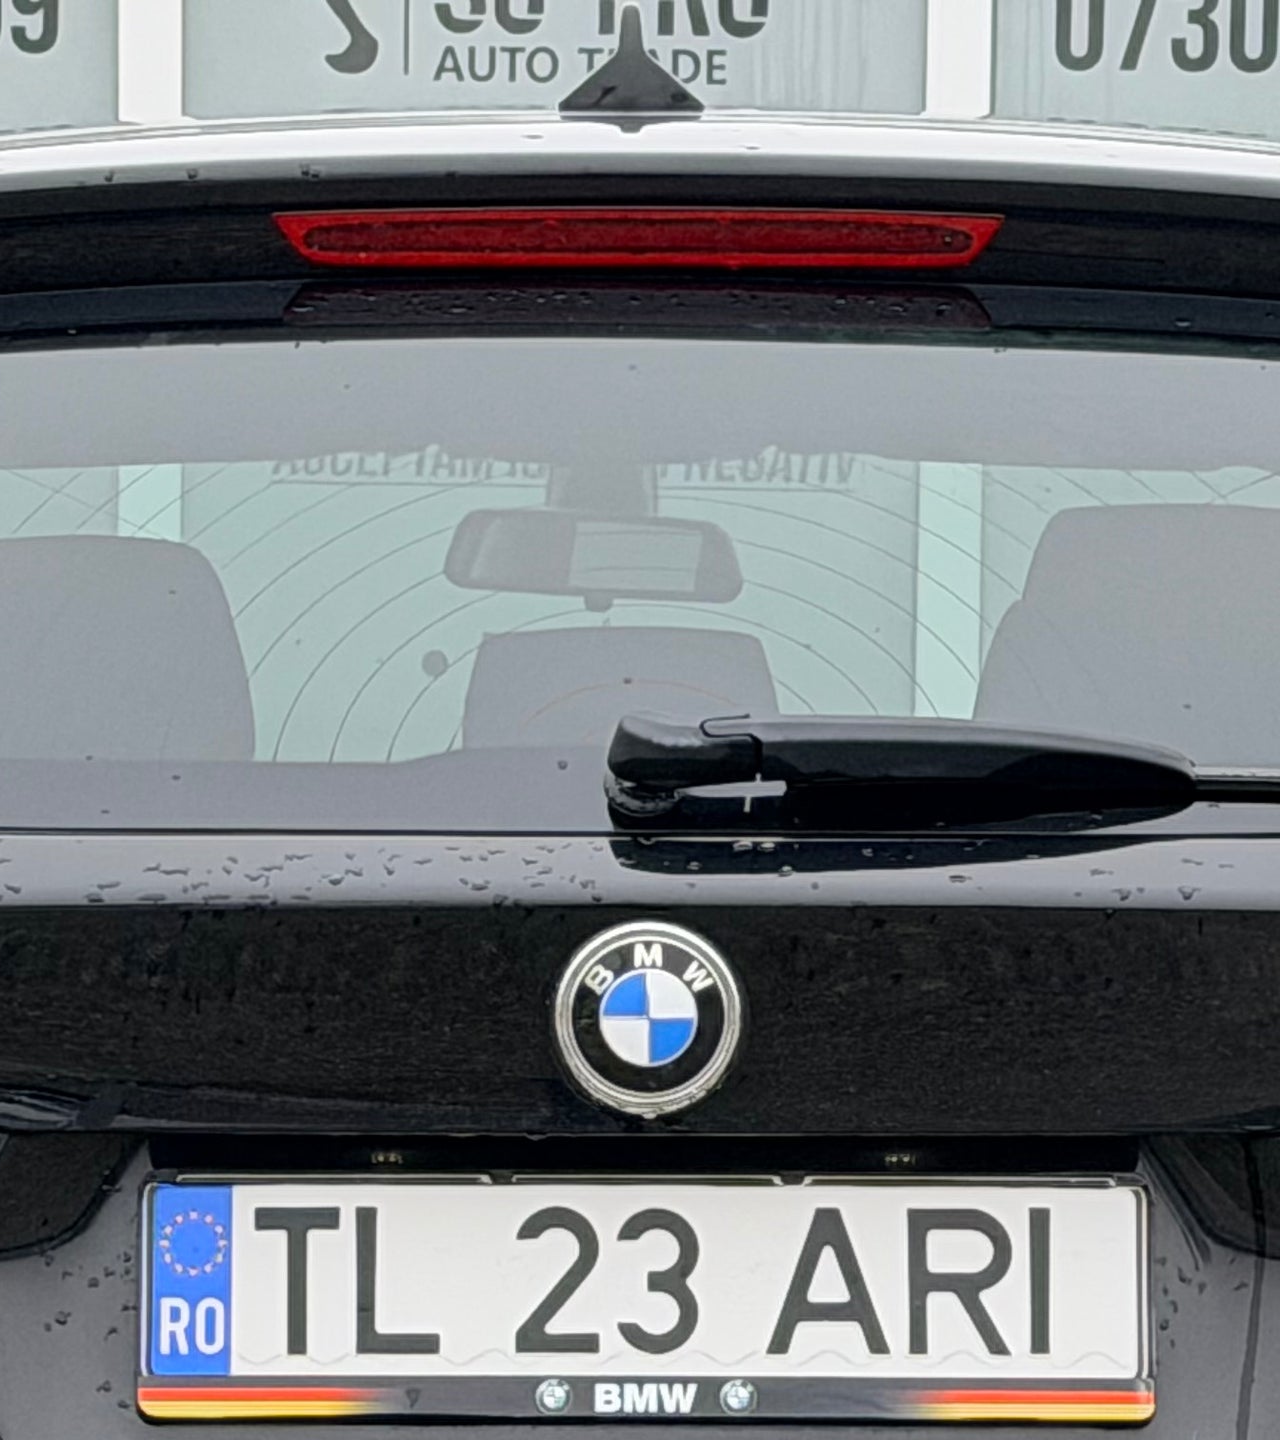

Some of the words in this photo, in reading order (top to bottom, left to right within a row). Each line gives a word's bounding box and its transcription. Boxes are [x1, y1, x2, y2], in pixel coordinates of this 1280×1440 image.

[433, 46, 560, 83] AUTO
[577, 48, 727, 85] TDE
[584, 943, 715, 996] BMW
[253, 1205, 441, 1356] TL
[516, 1205, 700, 1356] 23
[765, 1206, 1050, 1356] ARI
[159, 1297, 225, 1356] RO
[593, 1382, 698, 1414] BMW
